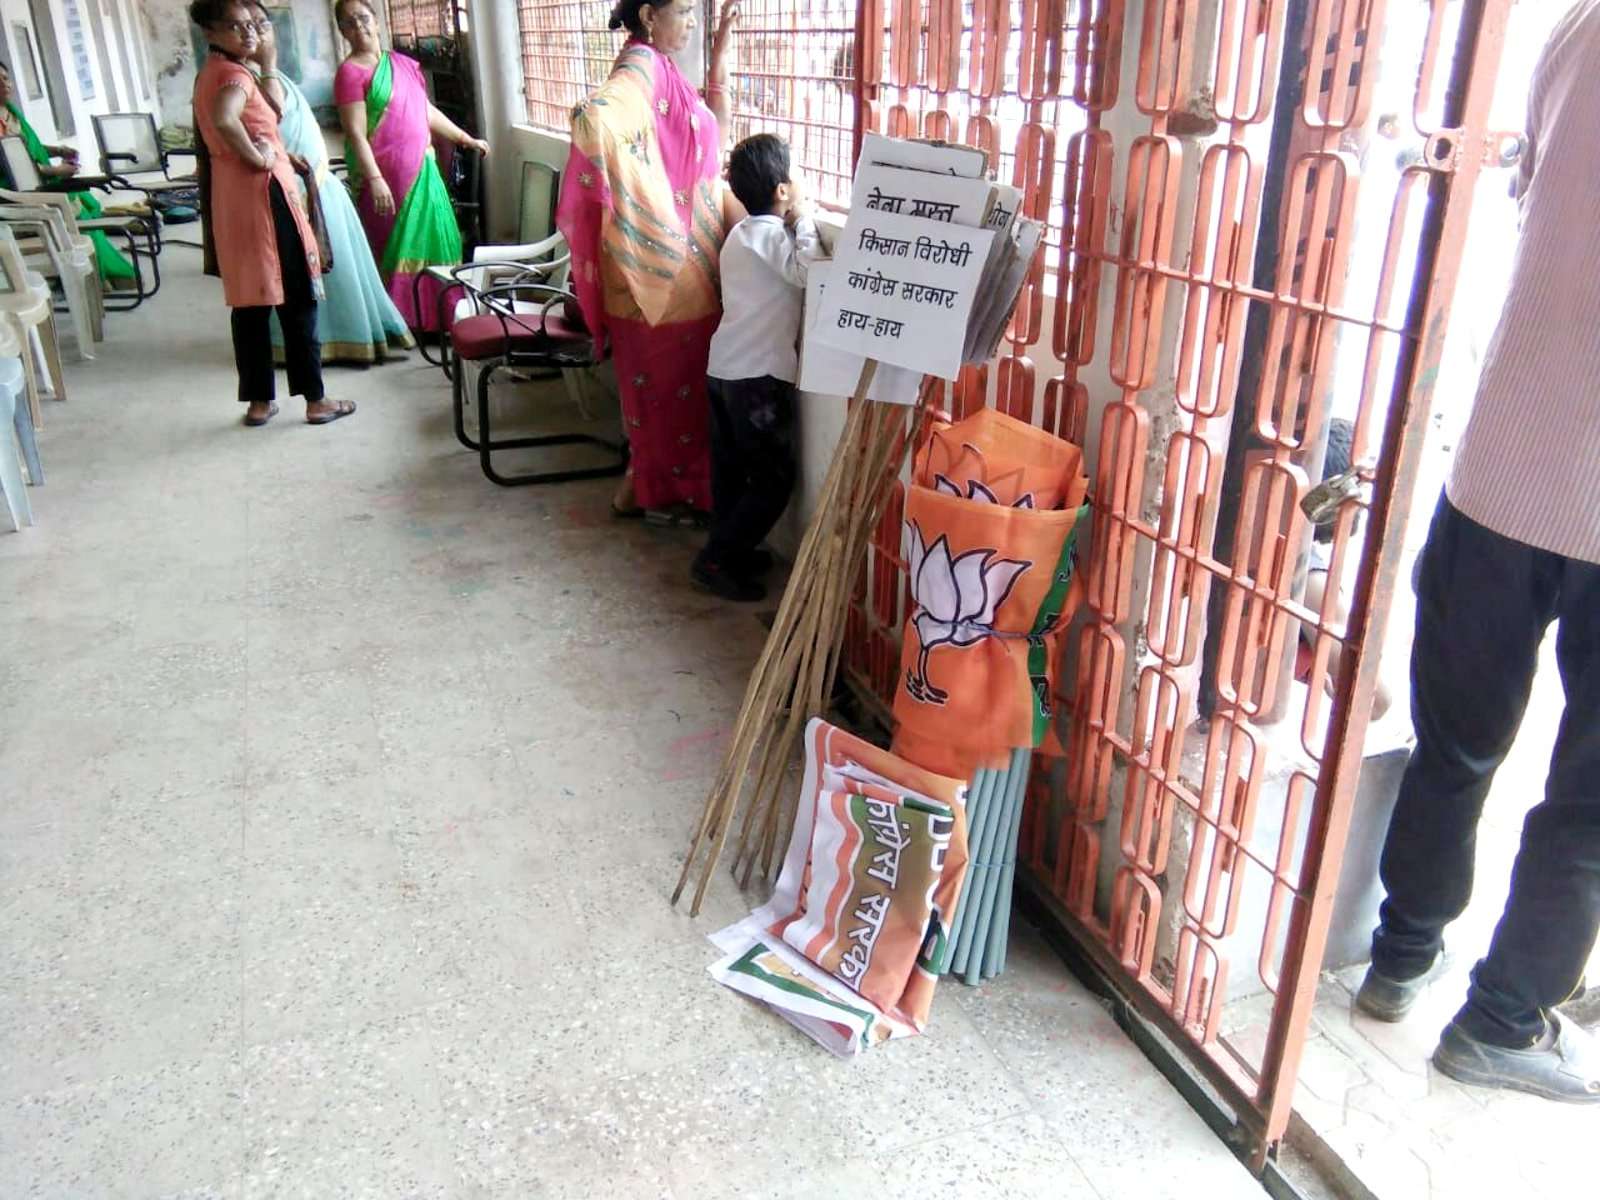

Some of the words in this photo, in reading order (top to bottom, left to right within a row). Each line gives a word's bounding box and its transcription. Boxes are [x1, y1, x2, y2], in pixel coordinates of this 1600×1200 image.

[858, 228, 912, 258] किसान
[913, 236, 973, 267] विरोधी
[848, 267, 900, 296] कांग्रेस
[901, 281, 959, 308] सरकार
[837, 308, 905, 339] हाय-हाय
